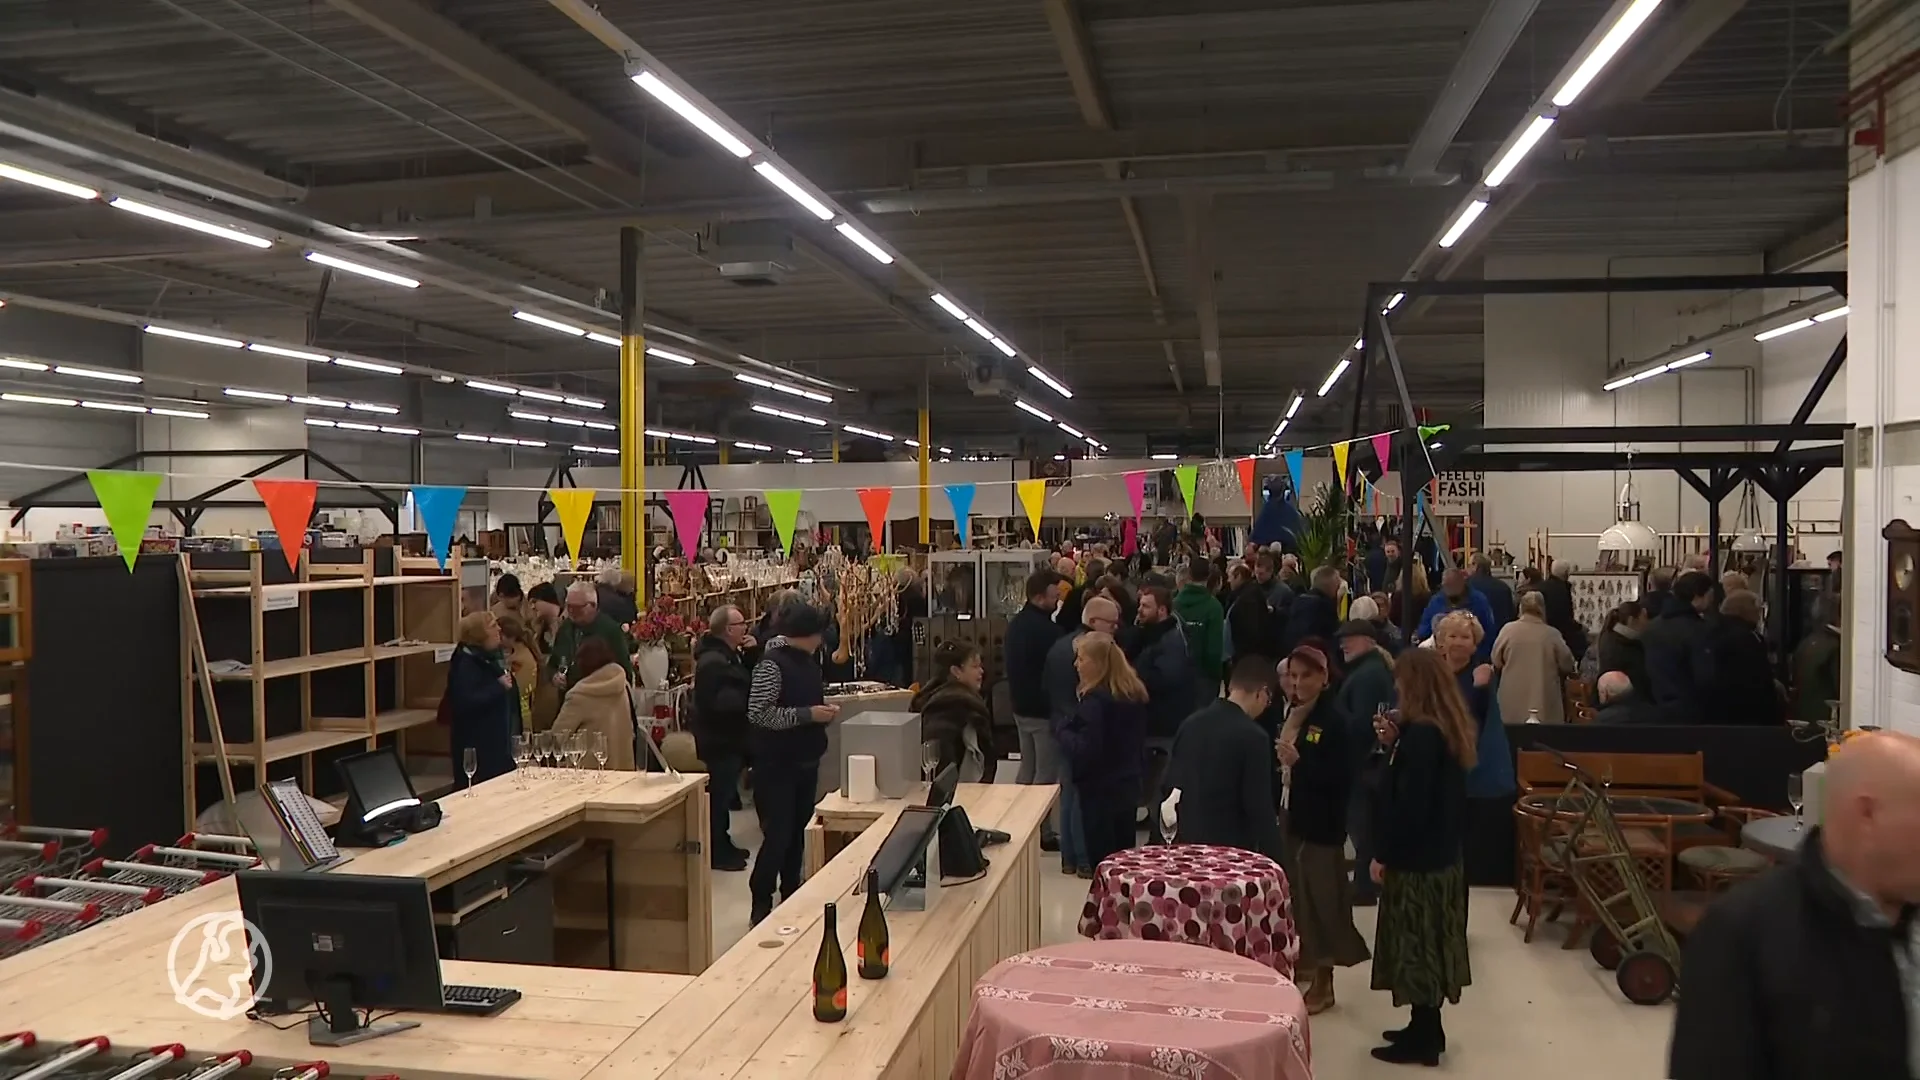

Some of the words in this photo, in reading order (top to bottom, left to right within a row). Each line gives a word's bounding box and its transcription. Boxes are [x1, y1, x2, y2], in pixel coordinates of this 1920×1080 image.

[1439, 471, 1469, 480] FEEL
[1474, 471, 1484, 480] G
[1439, 482, 1484, 496] FASHI
